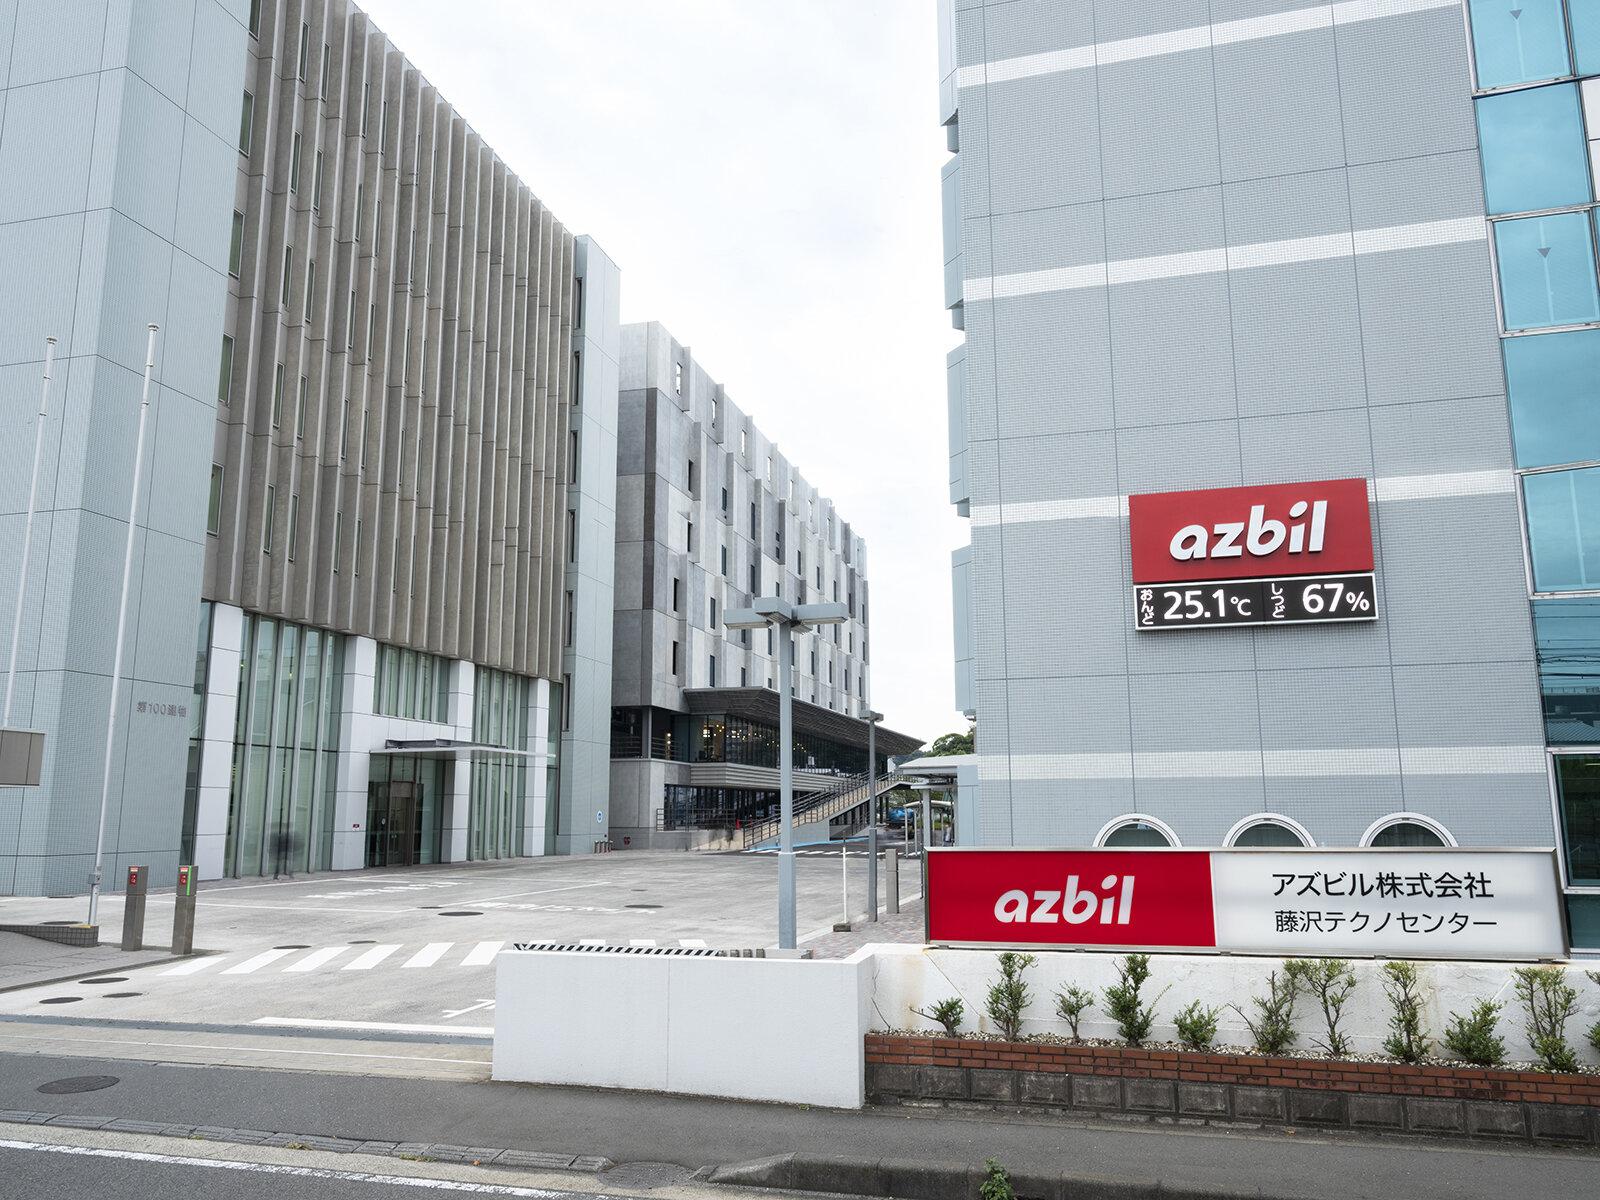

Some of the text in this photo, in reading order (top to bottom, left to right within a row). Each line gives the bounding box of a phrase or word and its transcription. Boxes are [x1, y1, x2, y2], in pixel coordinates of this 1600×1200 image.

[1170, 501, 1327, 559] azbil
[1140, 589, 1154, 625] おんど
[1271, 583, 1285, 618] しつど
[1303, 583, 1369, 613] 67%
[995, 875, 1134, 924] azbil
[1273, 872, 1494, 898] アズビル株式会社
[1275, 910, 1497, 934] 藤沢テクノセンター
